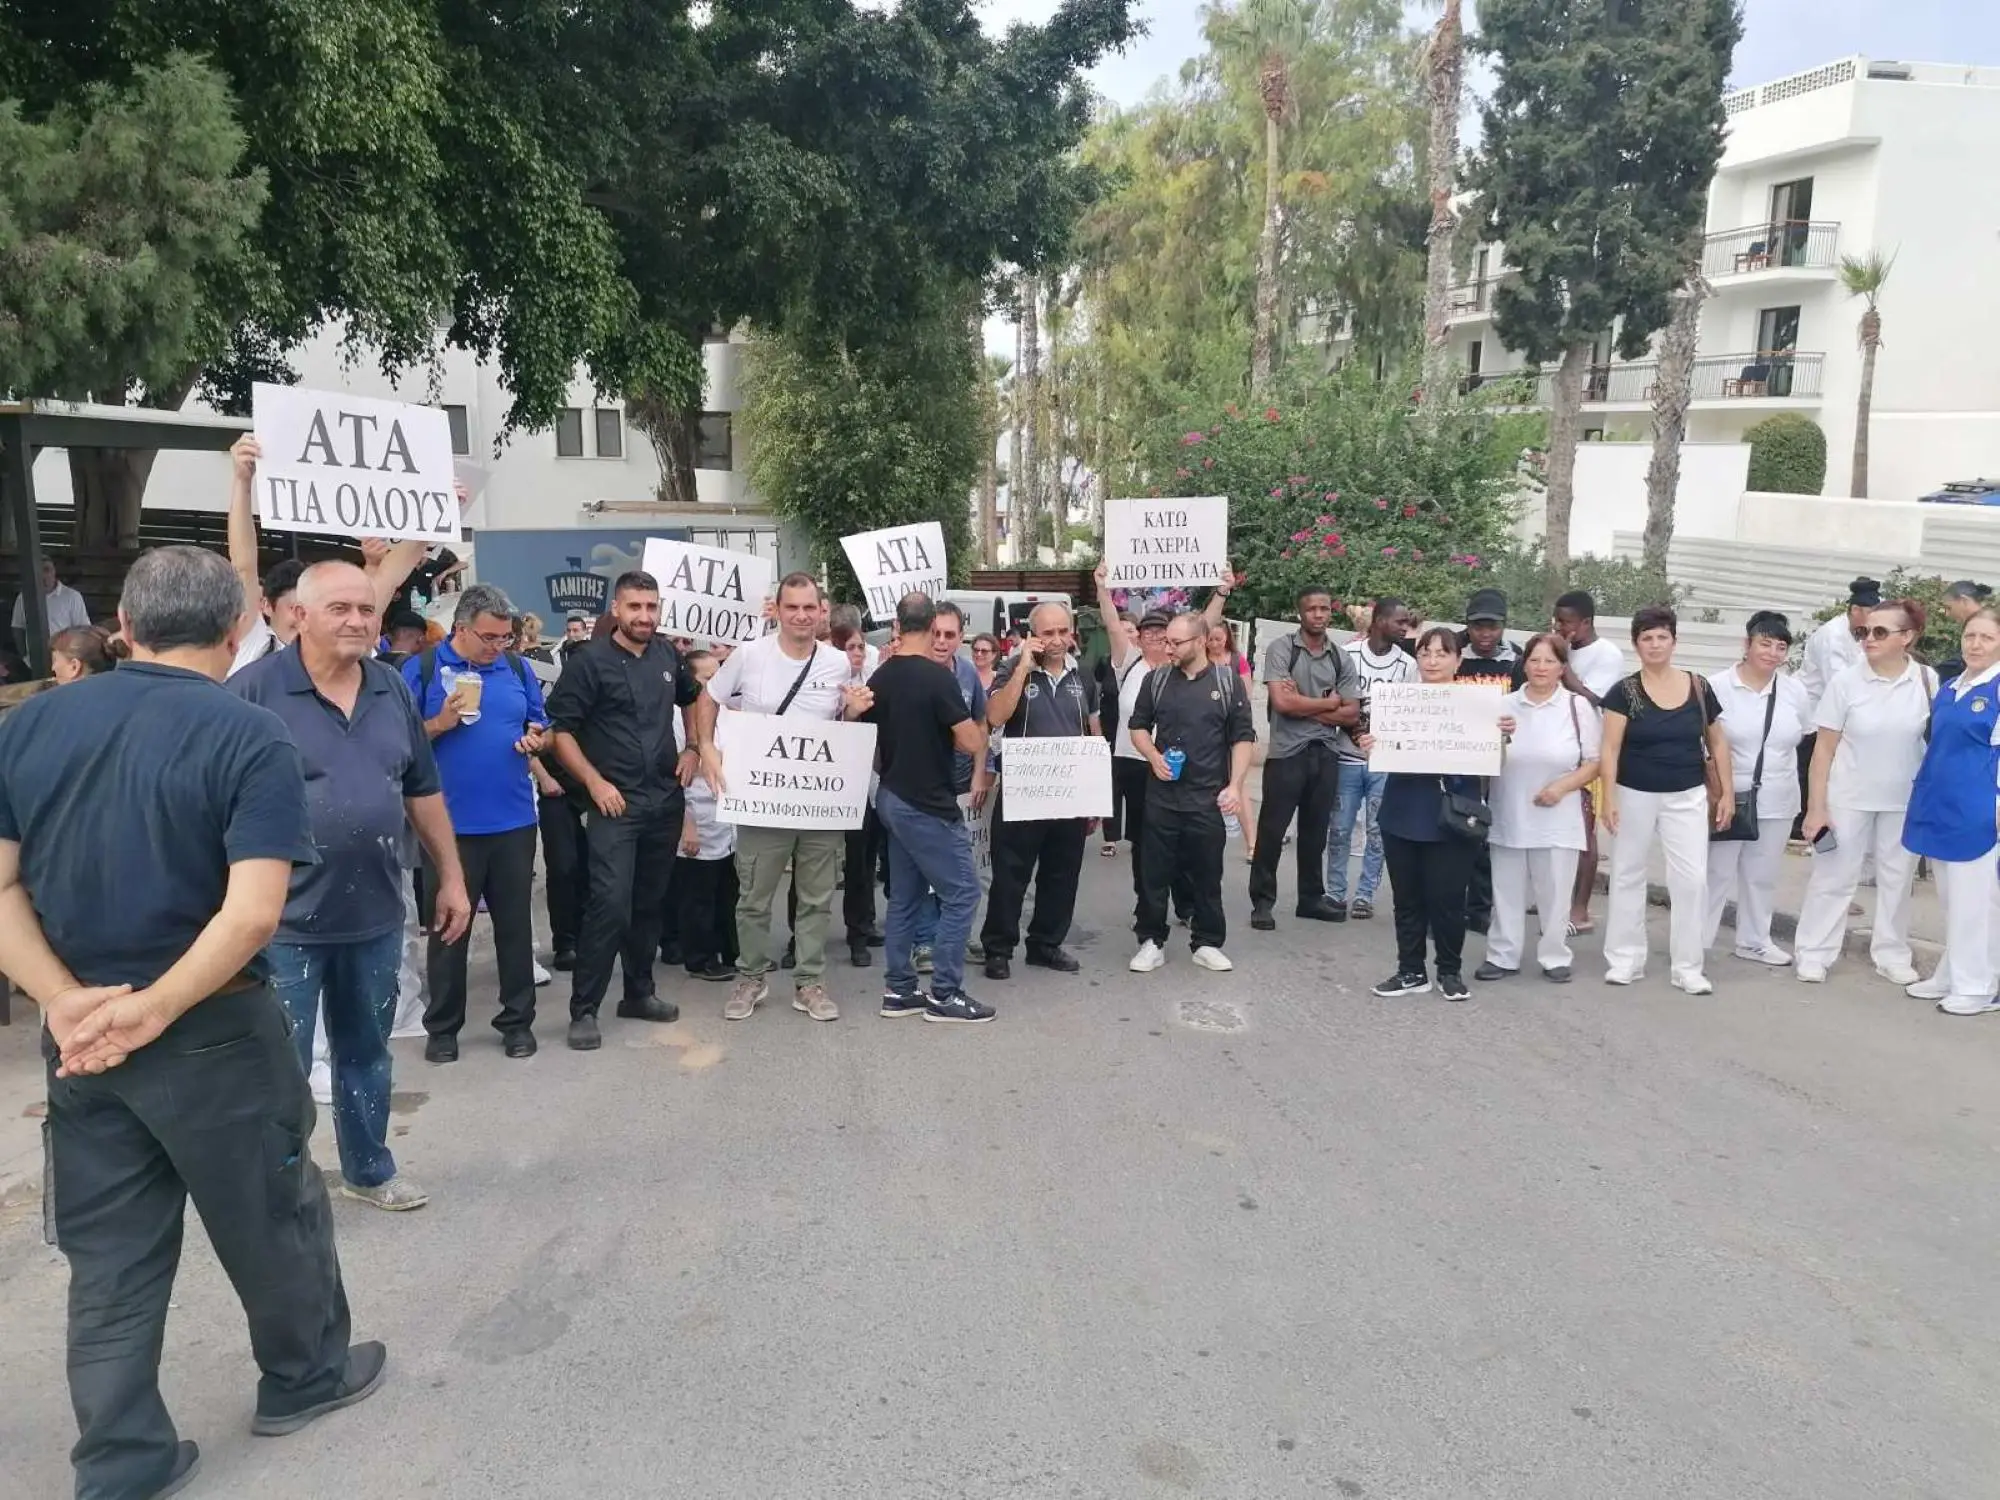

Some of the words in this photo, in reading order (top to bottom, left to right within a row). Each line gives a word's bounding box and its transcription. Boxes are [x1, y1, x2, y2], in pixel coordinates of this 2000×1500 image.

[296, 408, 421, 474] ΑΤΑ
[267, 476, 328, 524] ΓΙΑ
[335, 482, 452, 533] ΟΛΟΥΣ
[1144, 510, 1188, 528] ΚΑΤΩ
[876, 535, 932, 576] ΑΤΑ
[1130, 537, 1149, 554] ΤΑ
[1154, 536, 1200, 553] ΧΕΡΙΑ
[664, 554, 745, 602] ΑΤΑ
[1112, 564, 1147, 580] ΑΠΟ
[1151, 563, 1185, 579] ΤΗΝ
[1191, 561, 1218, 578] ΑΤΑ
[551, 576, 605, 600] ΛΑΝΙΤΗΣ
[656, 597, 677, 629] ΙΑ
[685, 603, 758, 642] ΟΛΟΥΣ
[765, 735, 835, 763] ΑΤΑ
[749, 770, 845, 792] ΣΕΒΑΣΜΟ
[723, 797, 748, 813] ΣΤΑ
[751, 799, 858, 819] ΣΥΜΦΩΝΗΘΕΝΤΑ
